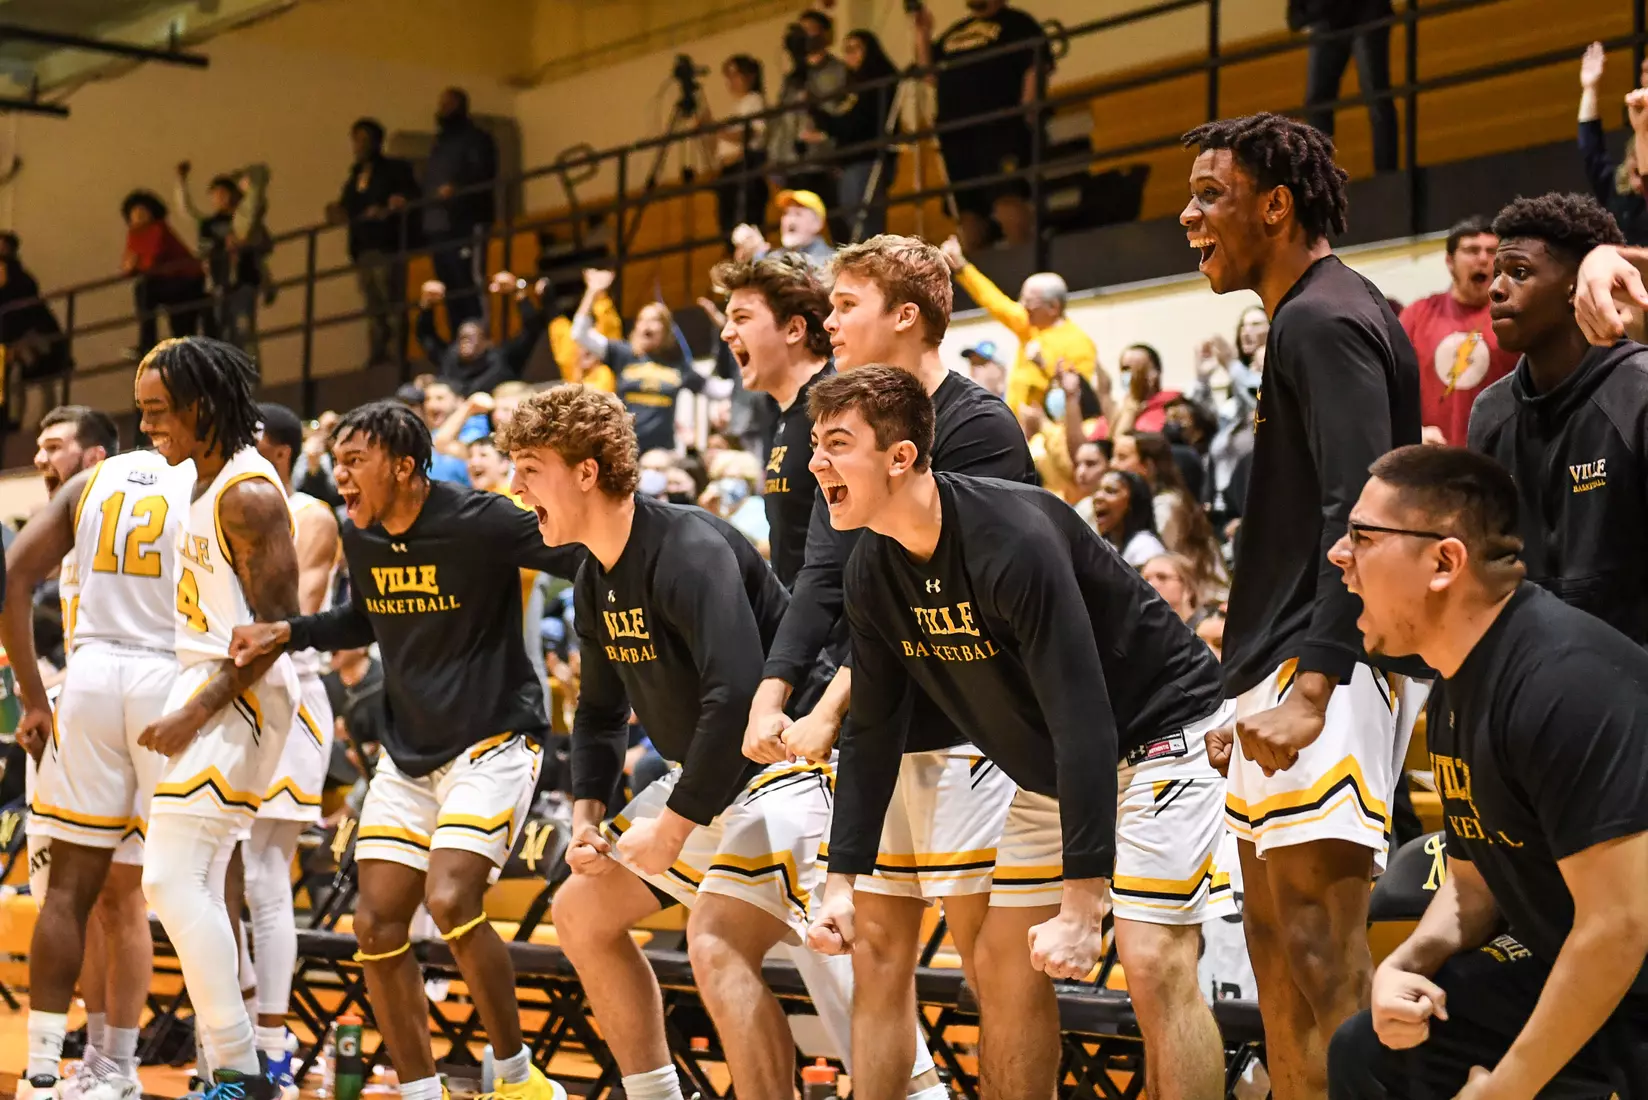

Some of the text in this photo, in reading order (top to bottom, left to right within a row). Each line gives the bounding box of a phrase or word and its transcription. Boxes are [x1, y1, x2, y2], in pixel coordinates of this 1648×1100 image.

[92, 491, 169, 578] 12
[371, 564, 439, 596] VILLE
[338, 1036, 357, 1057] G
